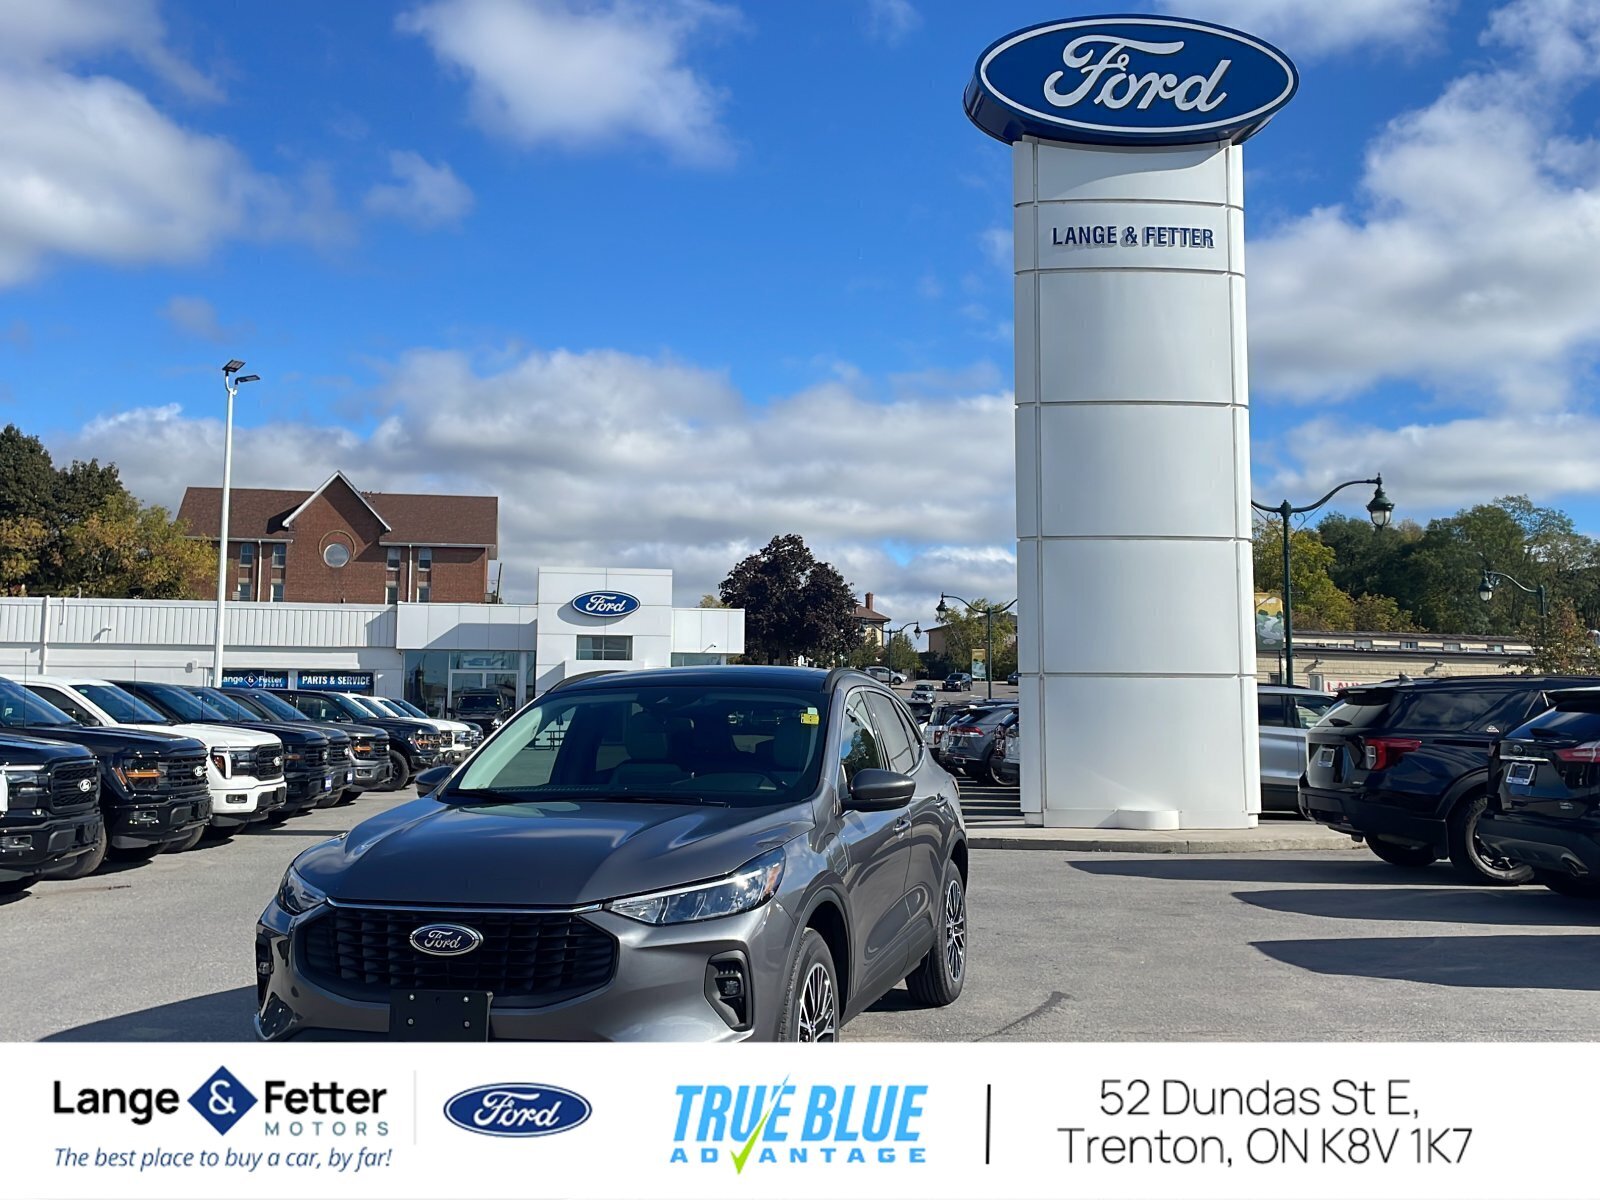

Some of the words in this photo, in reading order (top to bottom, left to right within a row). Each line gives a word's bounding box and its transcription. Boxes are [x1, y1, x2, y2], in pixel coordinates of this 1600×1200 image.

[1043, 34, 1232, 112] Ford
[1052, 226, 1117, 245] LANGE
[1125, 226, 1138, 245] &
[1146, 226, 1214, 247] FETTER
[585, 594, 627, 612] Ford
[222, 676, 243, 685] ange
[258, 676, 283, 684] Fetter
[302, 676, 328, 685] PARTS
[329, 676, 336, 685] &
[338, 676, 371, 685] SERVICE
[424, 930, 463, 949] Ford
